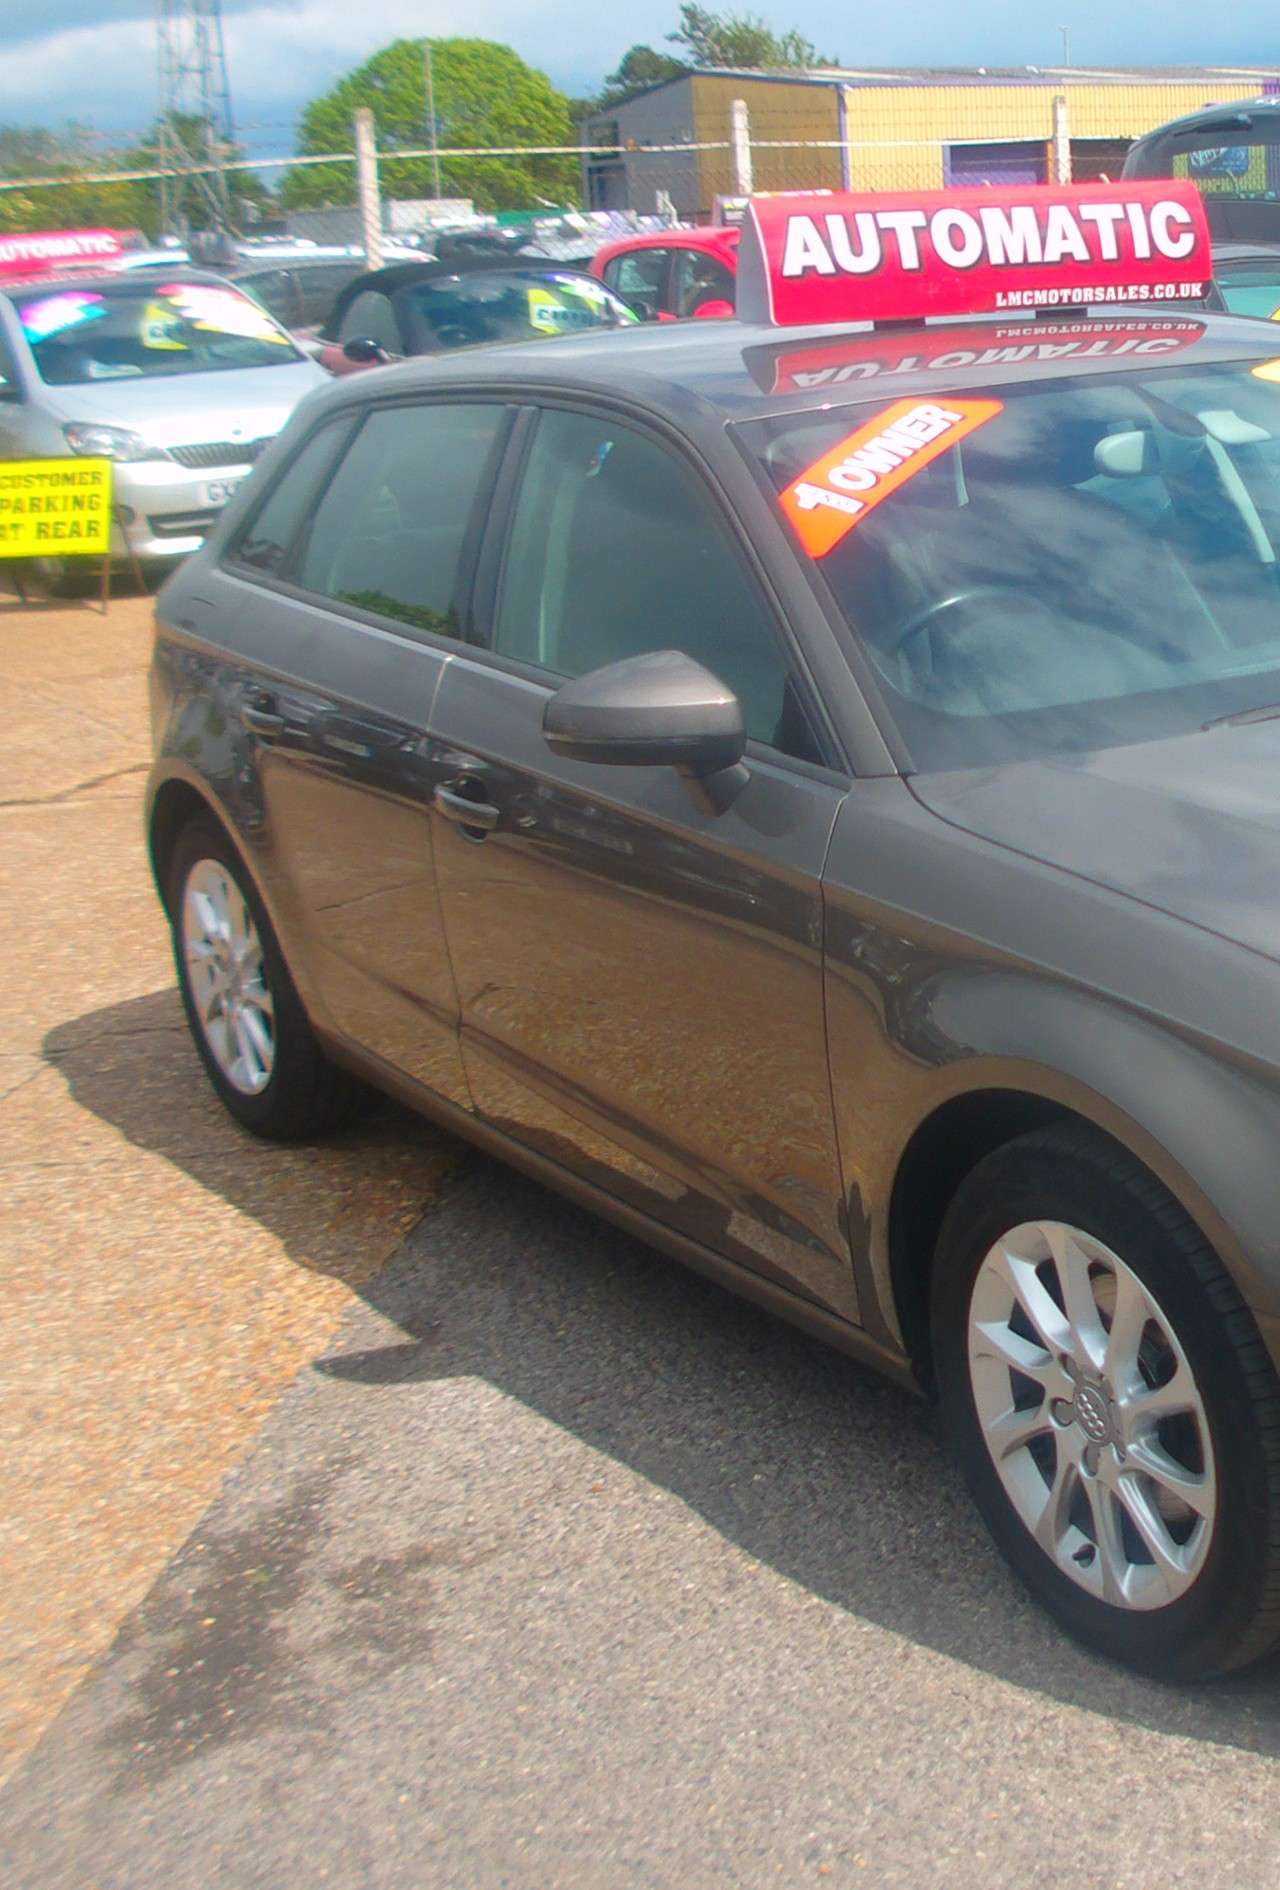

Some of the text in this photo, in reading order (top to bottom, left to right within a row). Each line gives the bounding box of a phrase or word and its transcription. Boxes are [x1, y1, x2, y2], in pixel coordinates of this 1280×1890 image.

[782, 199, 1196, 278] AUTOMATIC
[995, 282, 1203, 307] LMCMOTORSALES.CO.UK
[793, 402, 965, 515] 1 OWNER
[35, 520, 100, 540] REAR
